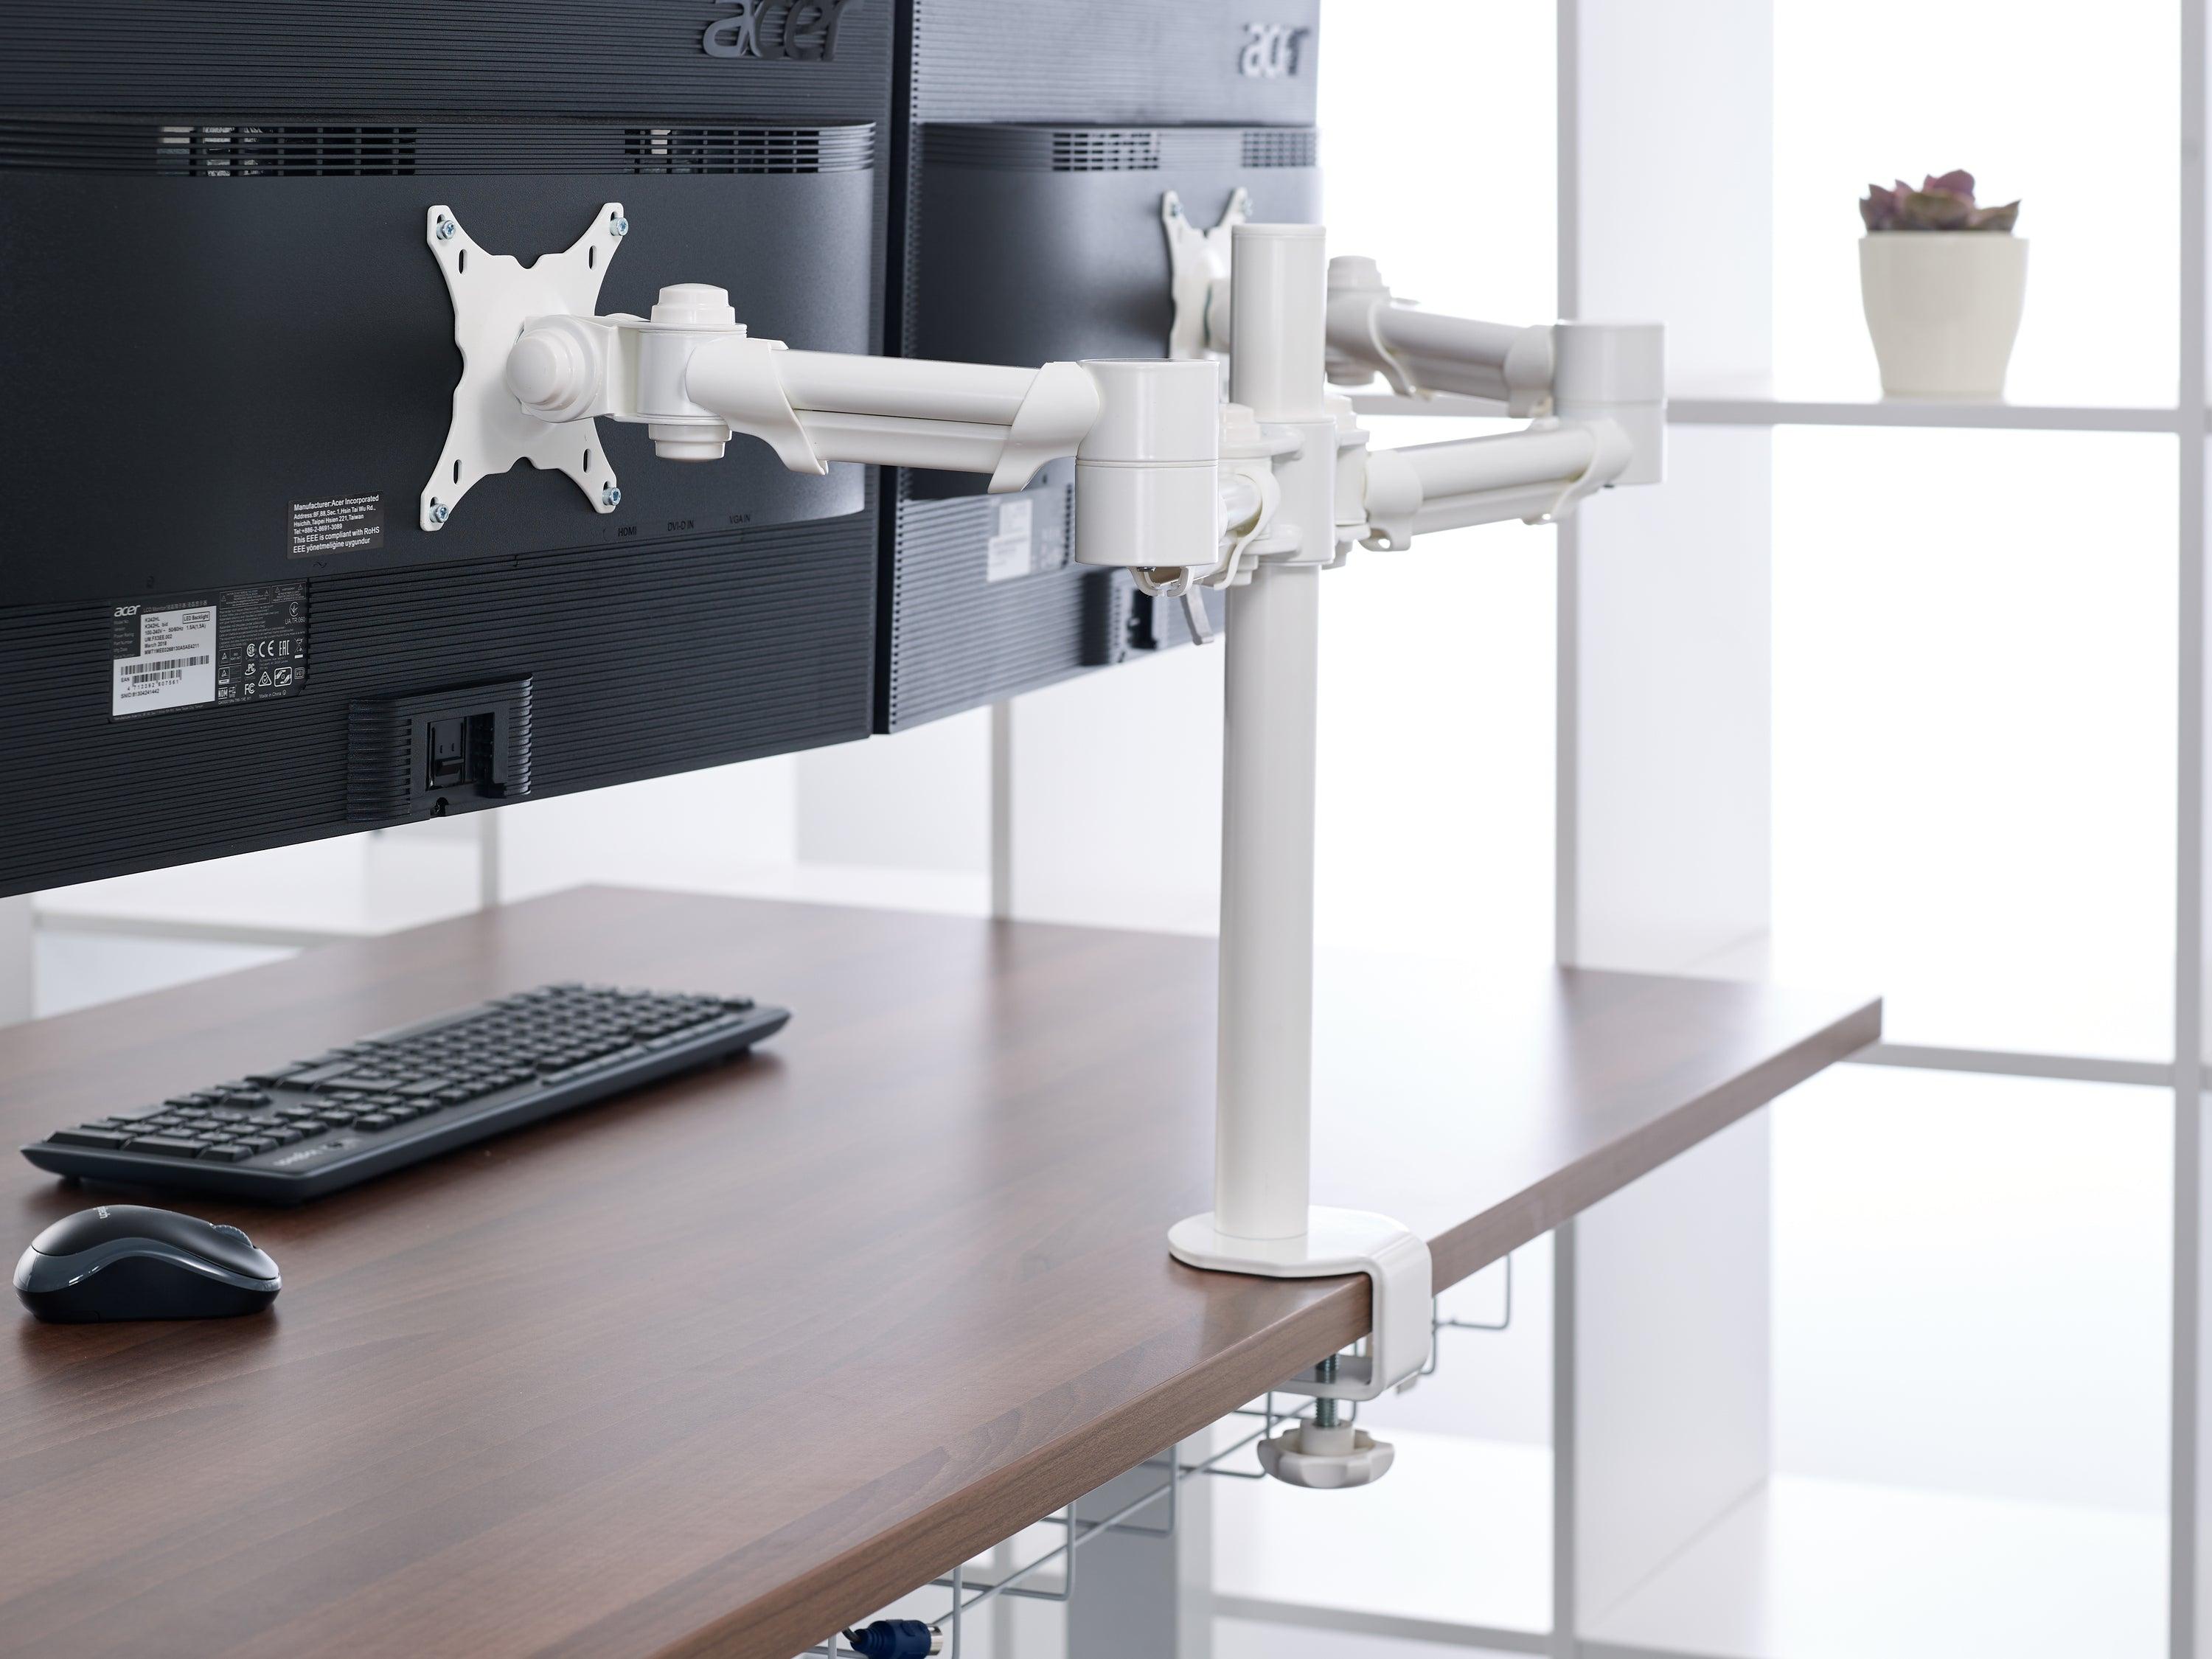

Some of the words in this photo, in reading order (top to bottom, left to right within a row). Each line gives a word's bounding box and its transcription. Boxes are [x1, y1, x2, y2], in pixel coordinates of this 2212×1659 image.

[703, 0, 858, 60] acer
[345, 495, 379, 505] Incorporated
[667, 521, 686, 531] DVI-D
[687, 520, 694, 529] IN
[729, 515, 743, 524] VGA
[306, 534, 319, 542] EEE
[325, 530, 351, 540] compliant
[364, 526, 380, 535] RoHS
[618, 526, 636, 537] HDMI
[293, 545, 305, 553] EEE
[345, 538, 370, 548] uygundur
[114, 605, 141, 617] acer
[259, 640, 274, 658] CE
